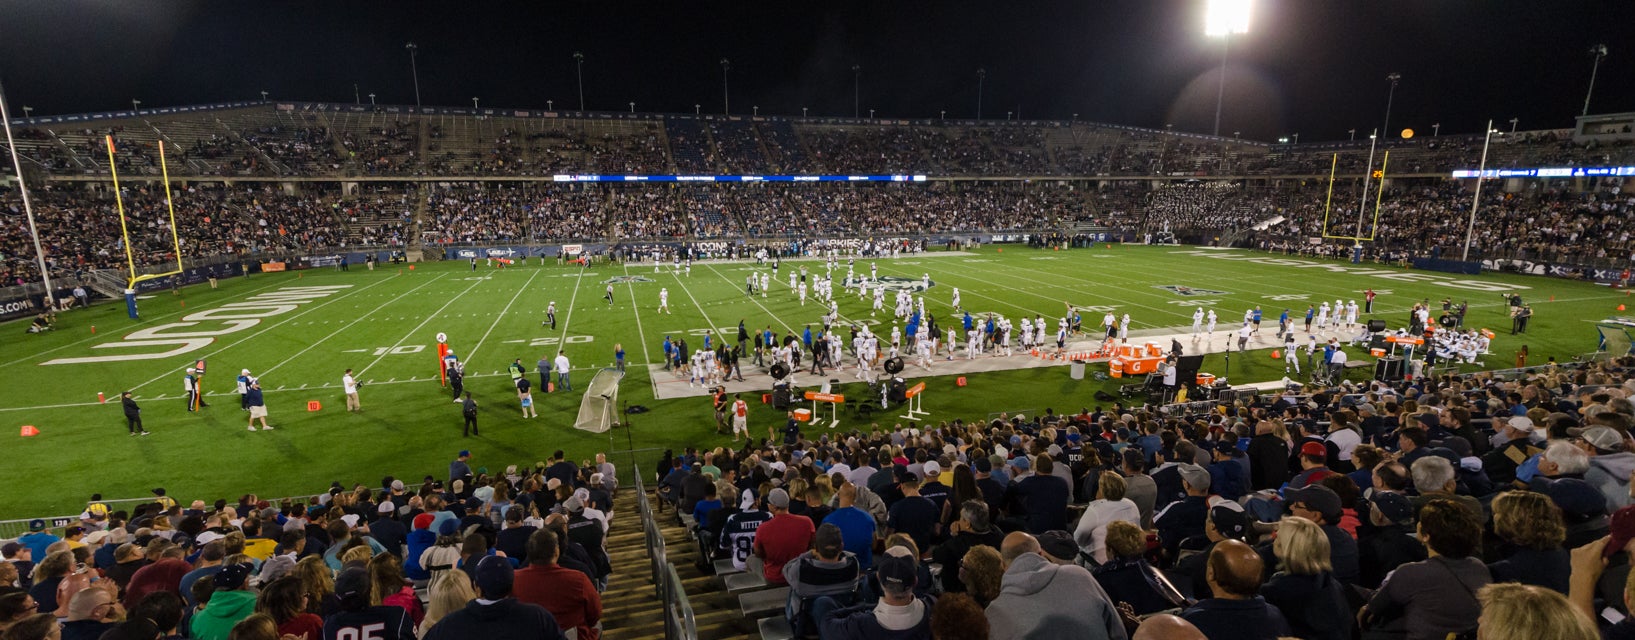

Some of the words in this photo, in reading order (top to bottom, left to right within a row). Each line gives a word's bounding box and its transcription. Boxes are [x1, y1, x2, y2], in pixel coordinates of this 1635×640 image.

[1373, 170, 1383, 178] 25
[39, 284, 355, 366] UCONN
[529, 335, 594, 346] 20
[372, 345, 427, 355] 10
[1132, 361, 1141, 372] G
[309, 402, 318, 410] 10
